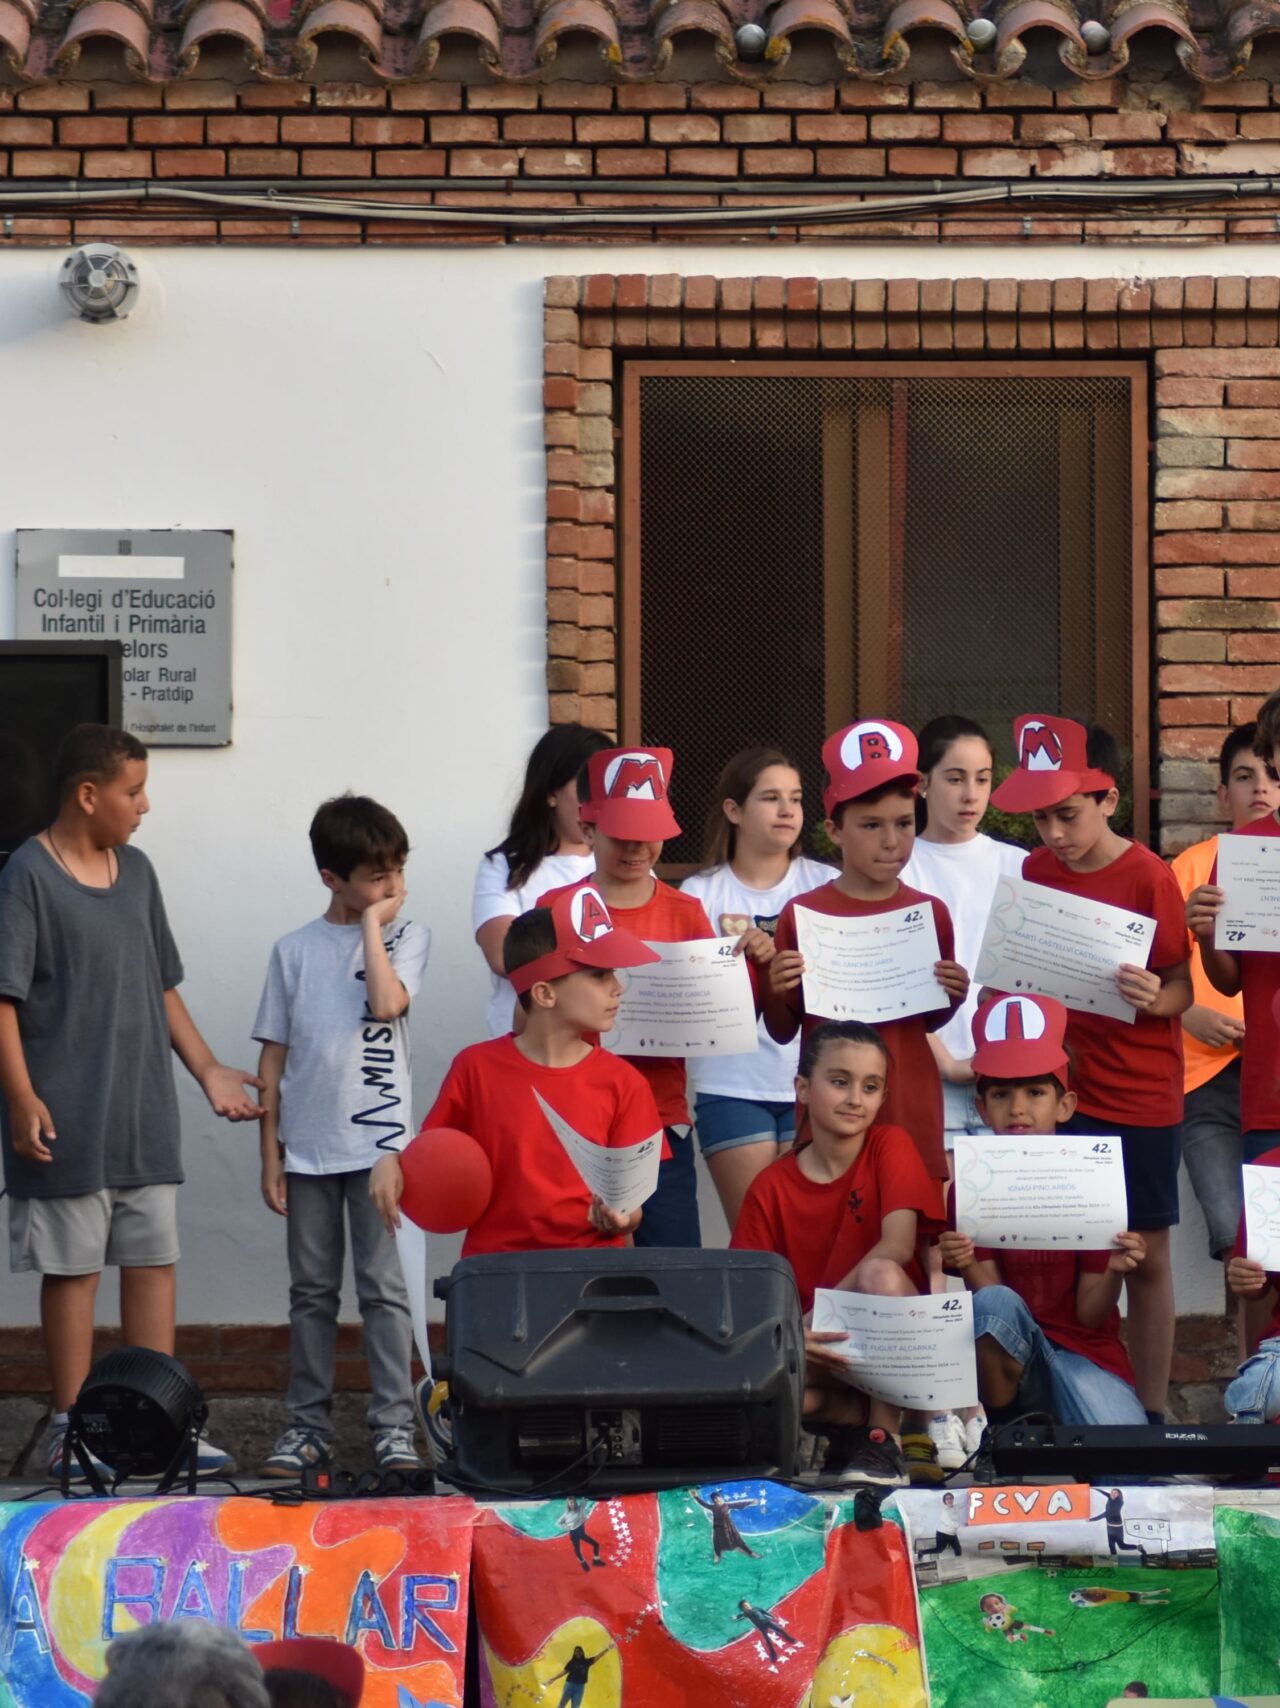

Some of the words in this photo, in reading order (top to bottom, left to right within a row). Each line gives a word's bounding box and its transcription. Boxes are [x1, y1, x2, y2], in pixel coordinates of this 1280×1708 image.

[34, 588, 102, 612] Col·legi
[112, 589, 216, 609] d'Educació
[42, 614, 104, 633] Infantil
[115, 615, 119, 633] i
[129, 615, 206, 634] Primària
[159, 667, 197, 682] Rural
[142, 686, 194, 704] Pratdip
[1020, 725, 1062, 771] M
[608, 758, 665, 800] M
[580, 892, 613, 939] A
[967, 1489, 1074, 1521] FCVA
[4, 1553, 52, 1656] A
[103, 1555, 459, 1654] BALLAR
